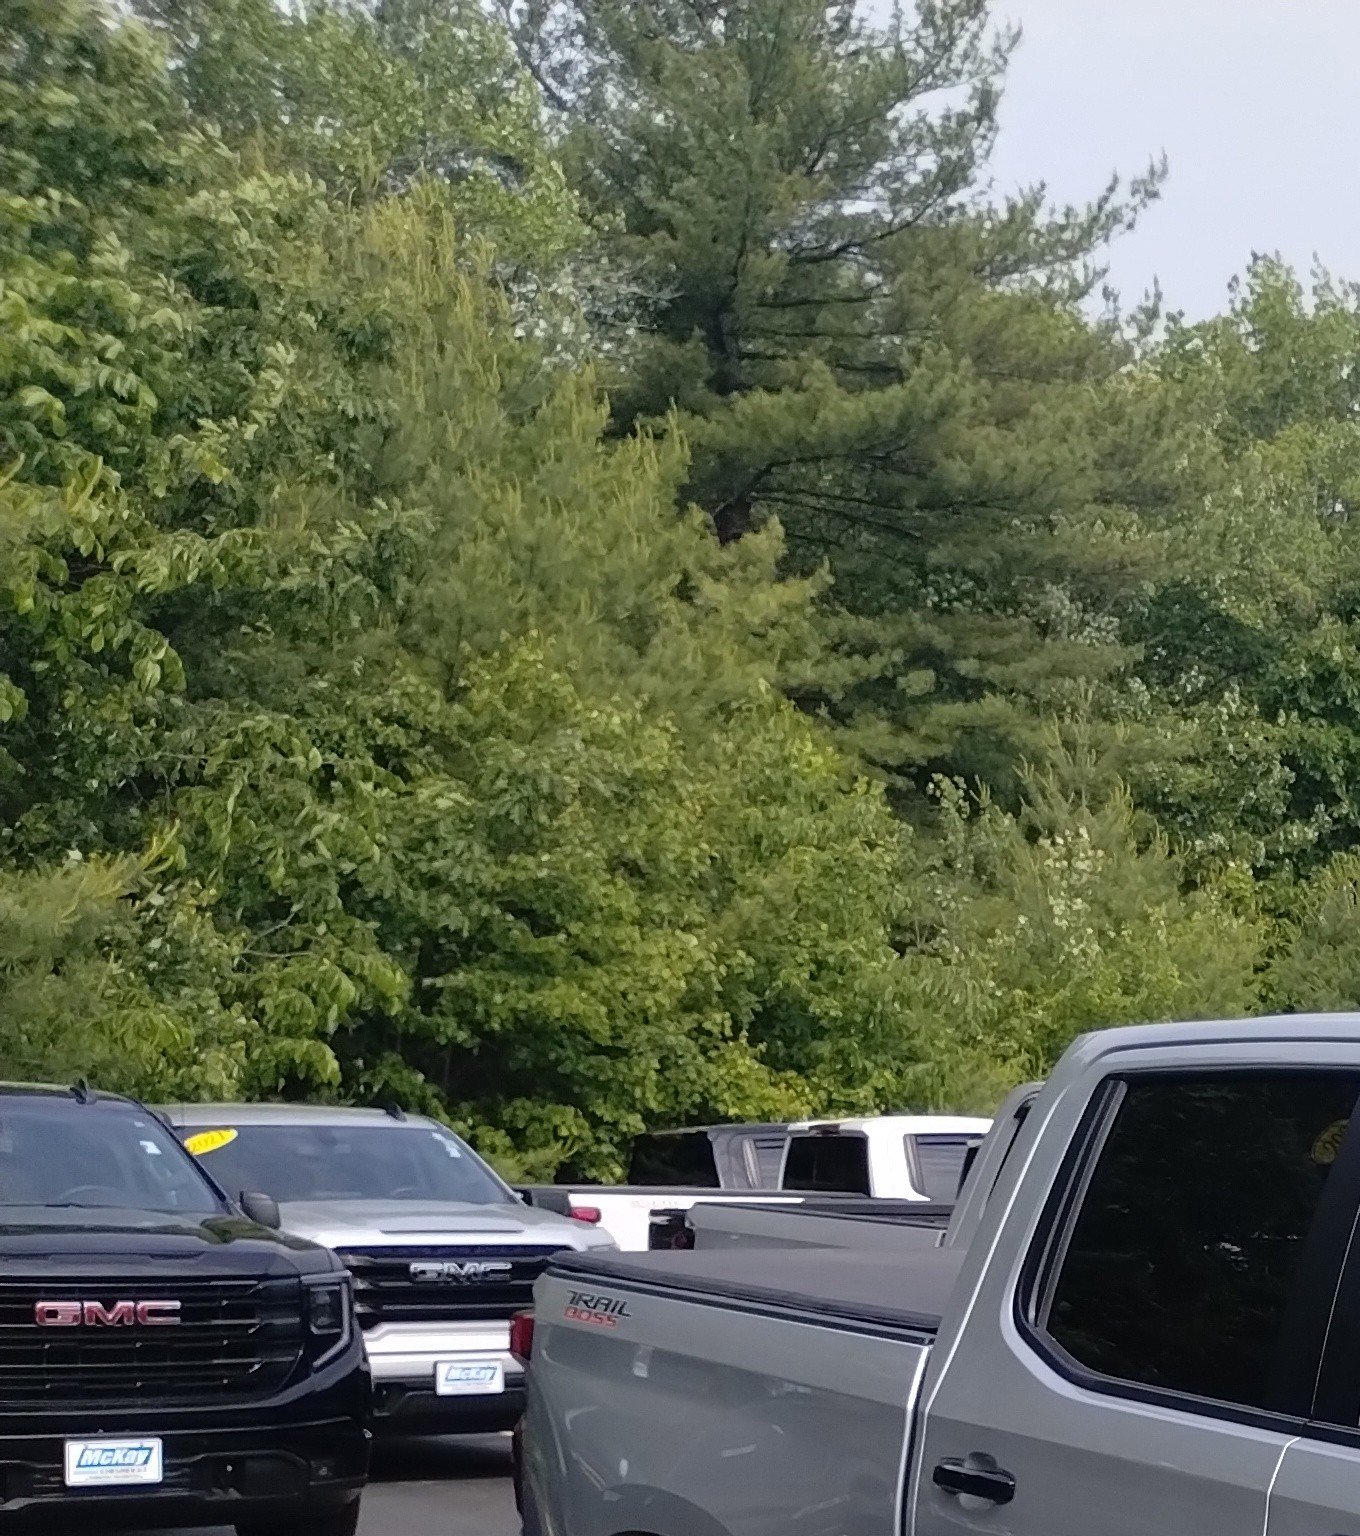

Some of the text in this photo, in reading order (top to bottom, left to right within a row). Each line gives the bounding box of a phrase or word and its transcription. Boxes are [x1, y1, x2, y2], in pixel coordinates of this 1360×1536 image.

[35, 1300, 182, 1327] GMC
[567, 1290, 632, 1317] TRAIL
[564, 1306, 618, 1328] BOSS
[80, 1447, 151, 1467] McKay
